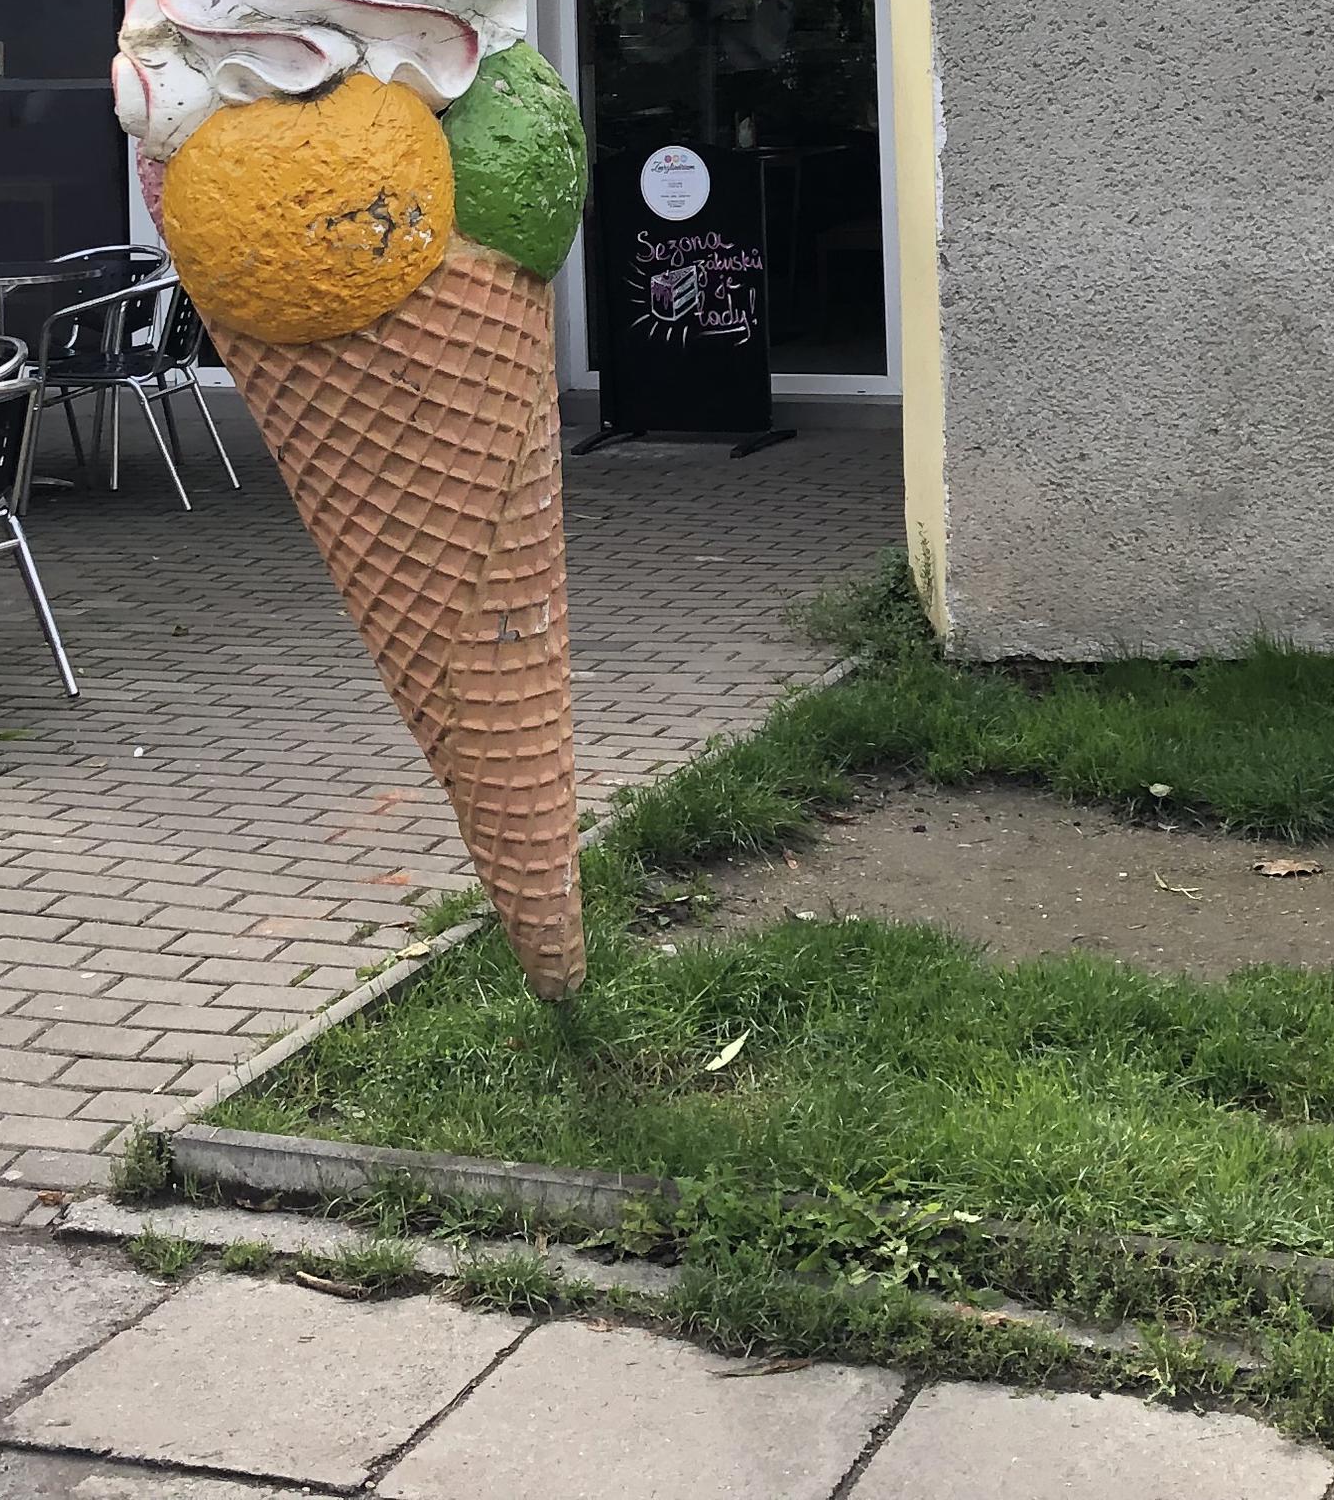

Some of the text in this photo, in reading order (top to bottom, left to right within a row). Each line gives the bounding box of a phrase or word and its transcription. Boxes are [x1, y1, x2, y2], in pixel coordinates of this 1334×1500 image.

[636, 231, 734, 267] Sezona
[714, 274, 742, 299] je
[694, 287, 758, 346] tady!
